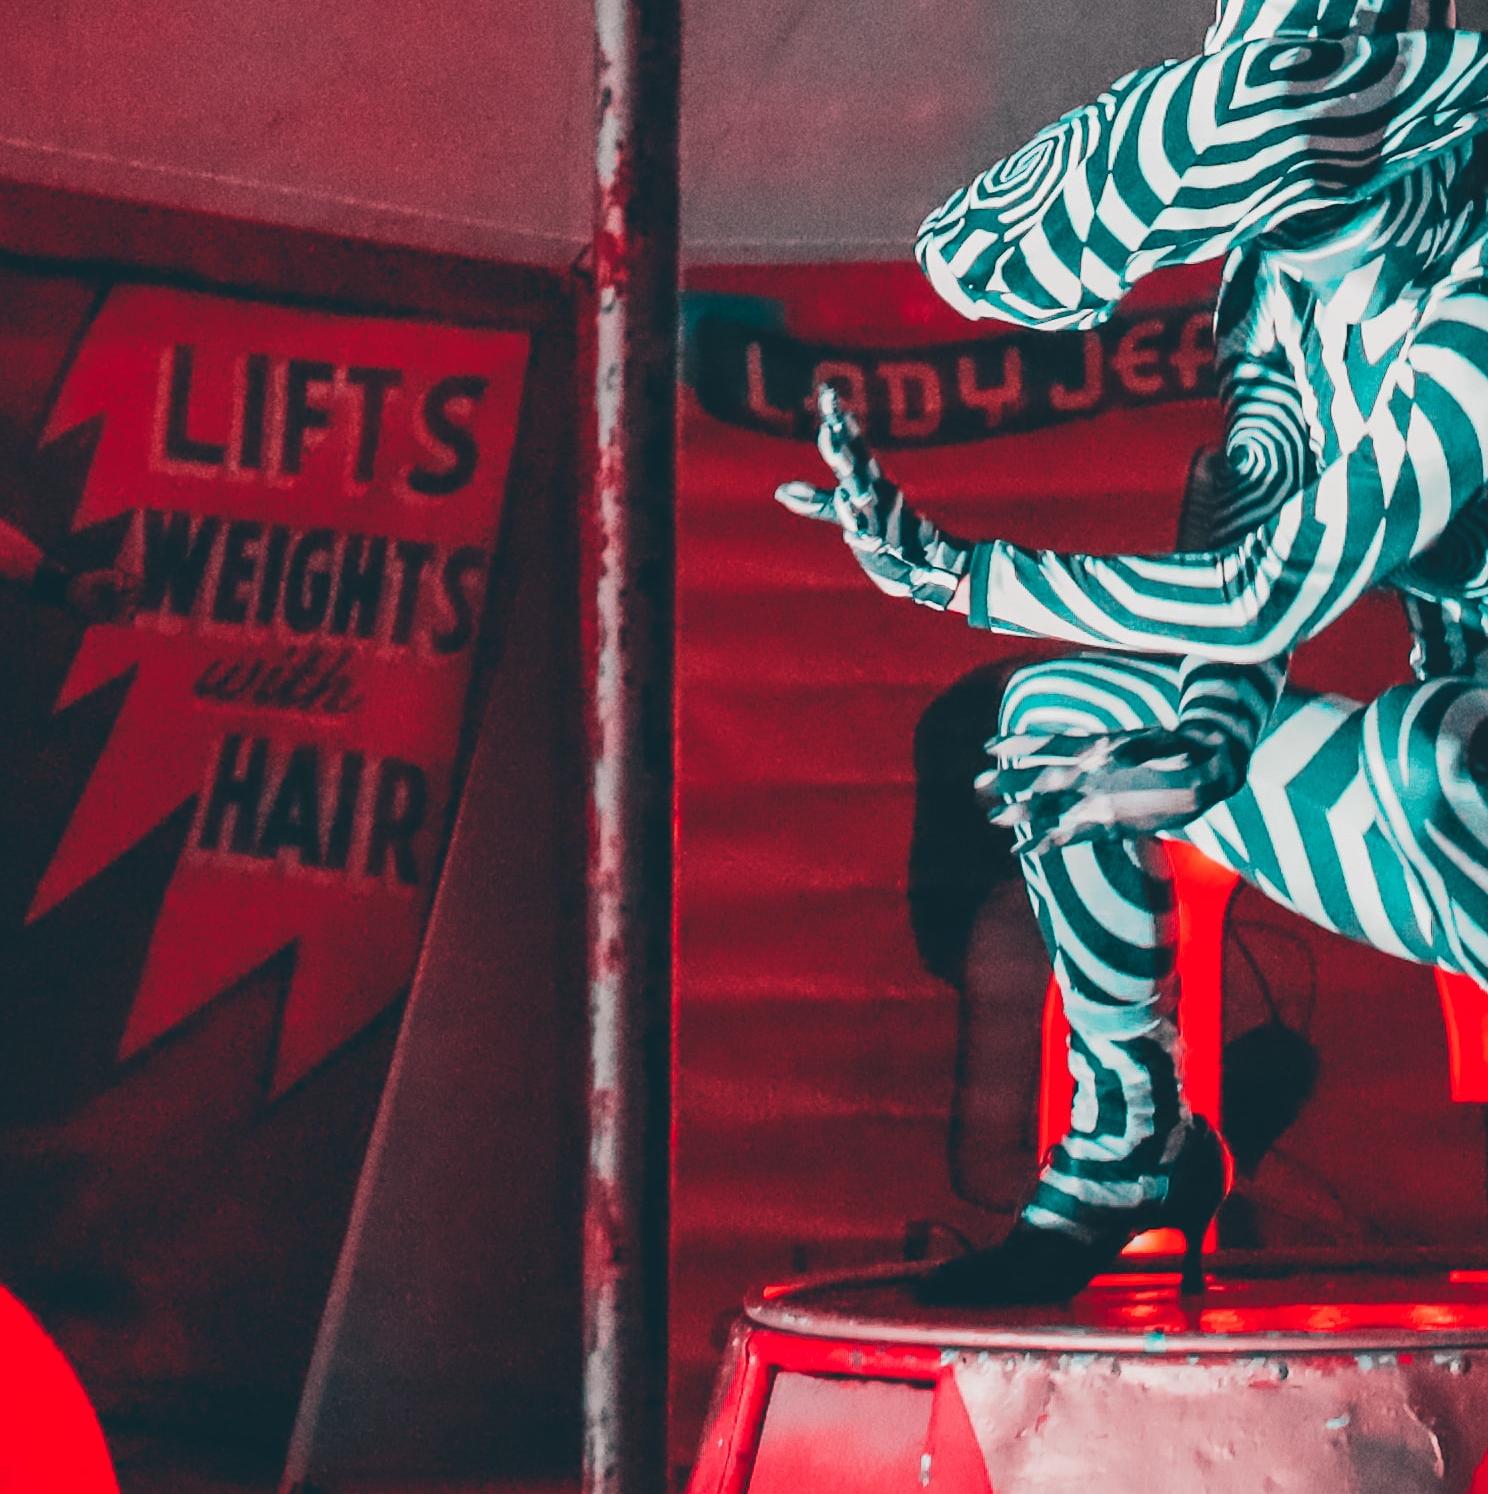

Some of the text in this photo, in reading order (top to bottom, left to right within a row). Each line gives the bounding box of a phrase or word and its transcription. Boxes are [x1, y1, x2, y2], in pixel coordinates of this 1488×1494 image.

[160, 342, 490, 498] LIFTS
[142, 508, 497, 656] WEIGHTS
[193, 643, 366, 714] with
[199, 733, 429, 887] HAIR
